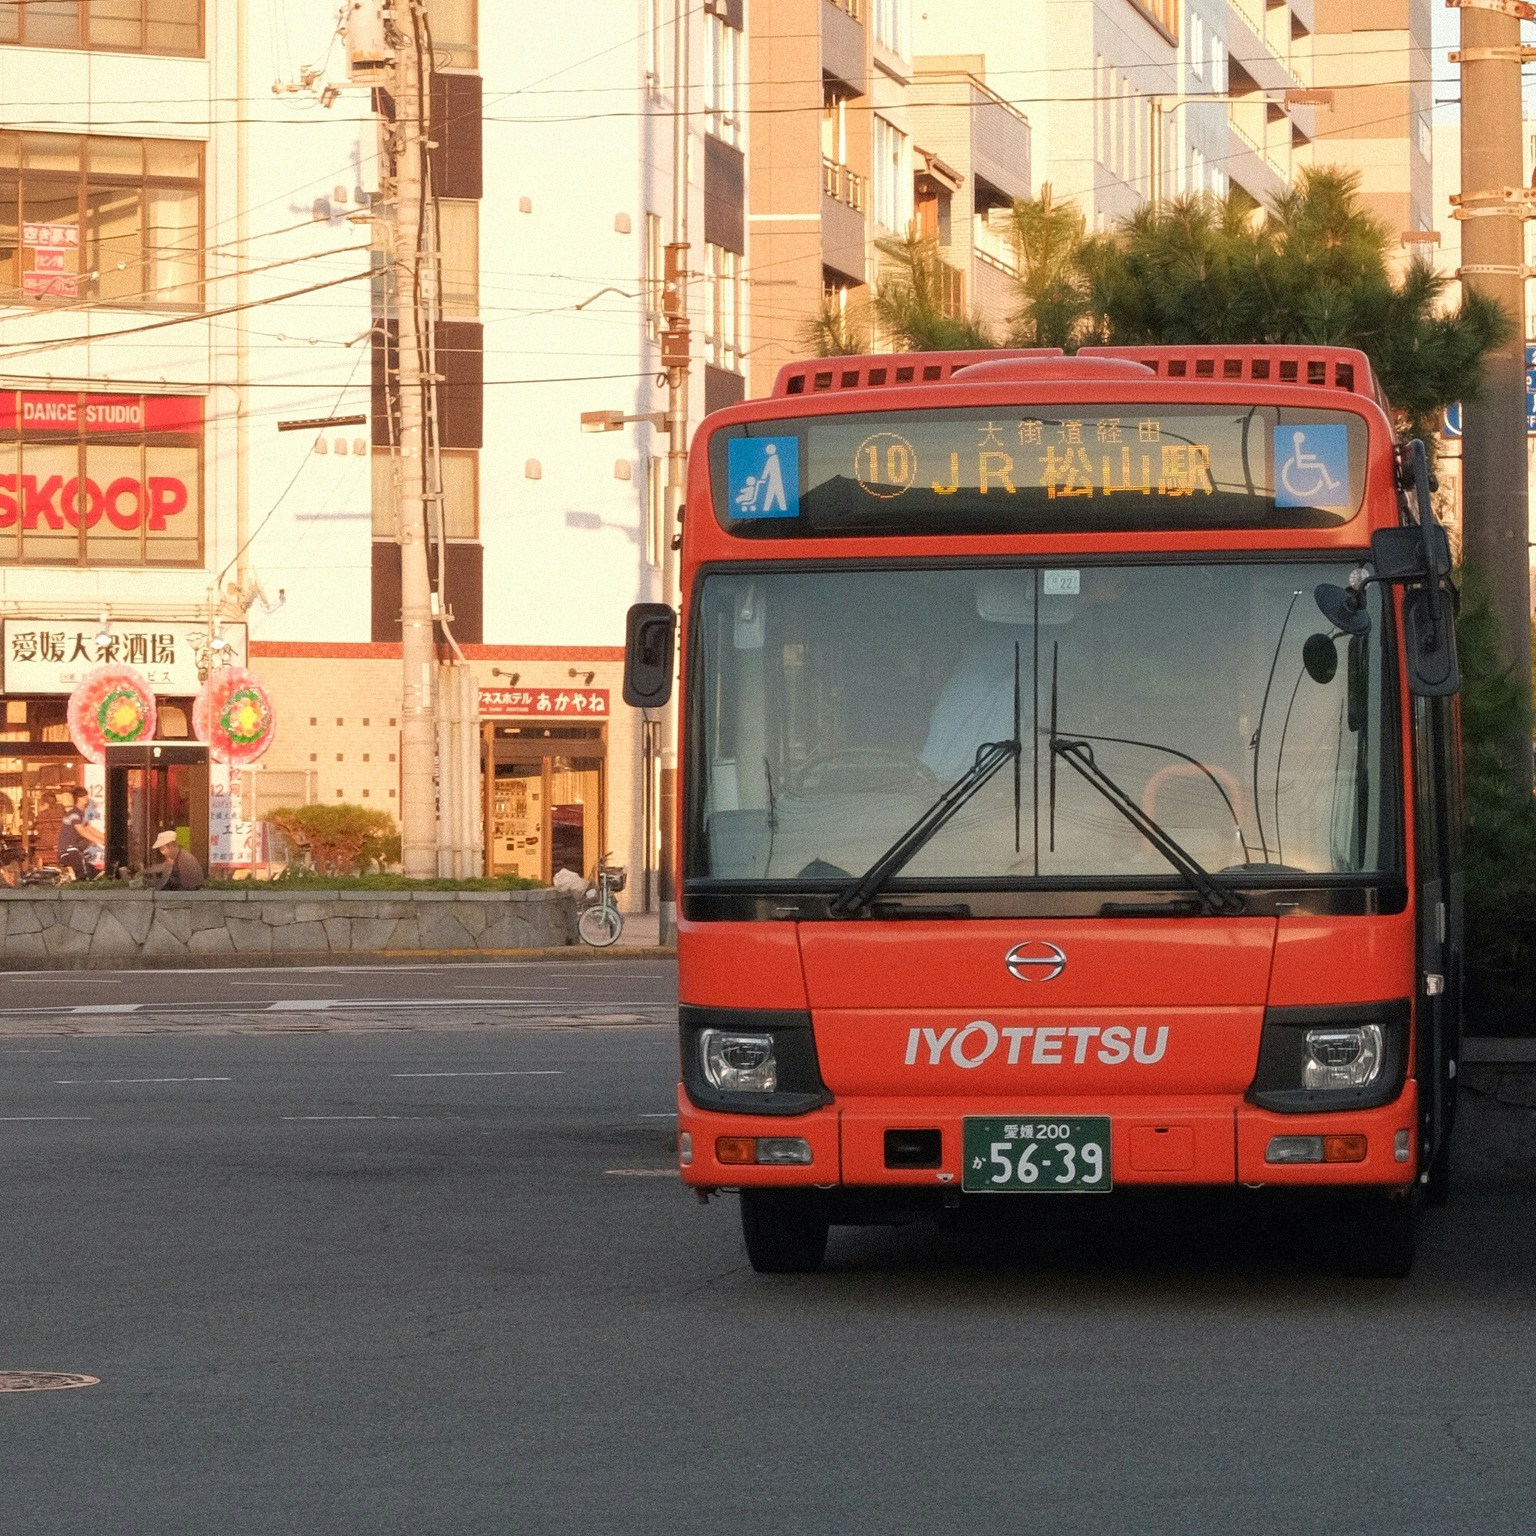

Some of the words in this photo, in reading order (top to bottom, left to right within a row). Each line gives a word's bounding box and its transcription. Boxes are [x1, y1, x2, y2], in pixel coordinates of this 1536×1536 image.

[23, 402, 78, 422] DANCE
[85, 404, 142, 424] STUDIO
[11, 631, 176, 665] 愛媛大衆酒場
[536, 691, 606, 712] あかやね
[904, 1020, 1170, 1069] IYOTETSU
[990, 1142, 1103, 1184] 56-39
